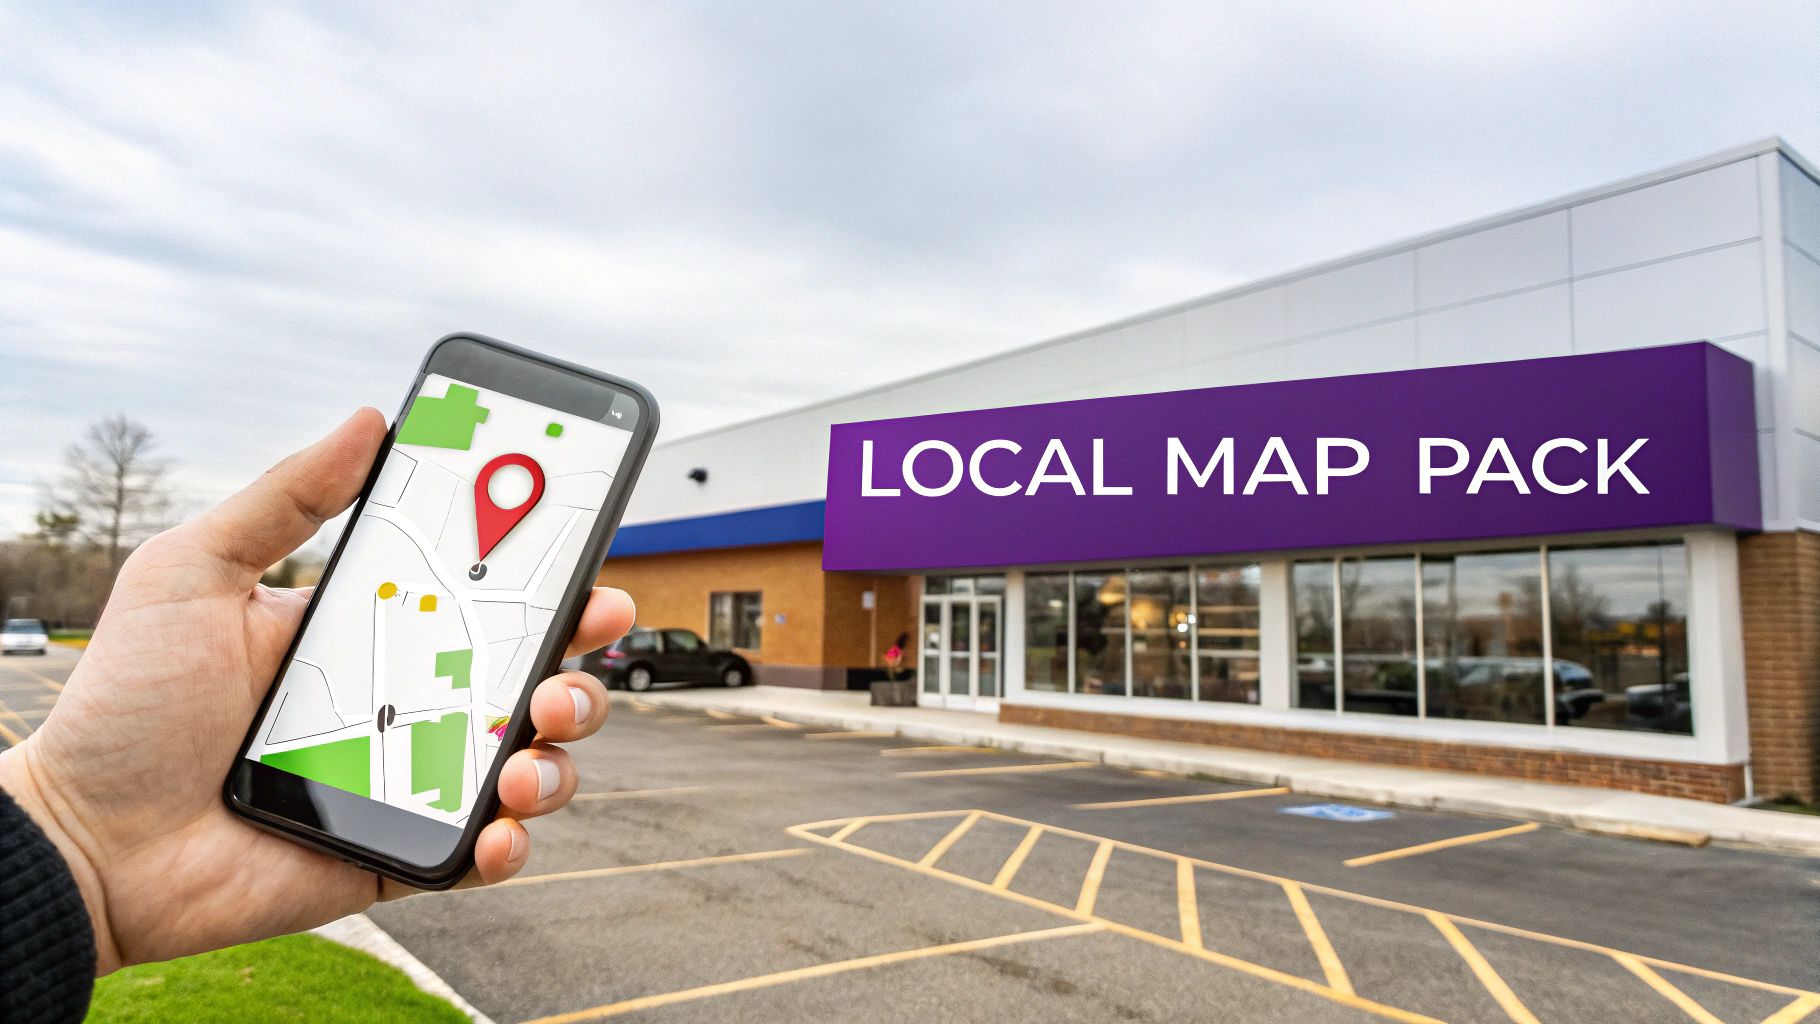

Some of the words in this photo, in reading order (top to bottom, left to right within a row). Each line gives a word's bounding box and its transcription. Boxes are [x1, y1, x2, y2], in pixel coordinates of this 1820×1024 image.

[860, 438, 1133, 498] LOCAL
[1166, 436, 1370, 496] MAP
[1419, 436, 1651, 496] PACK
